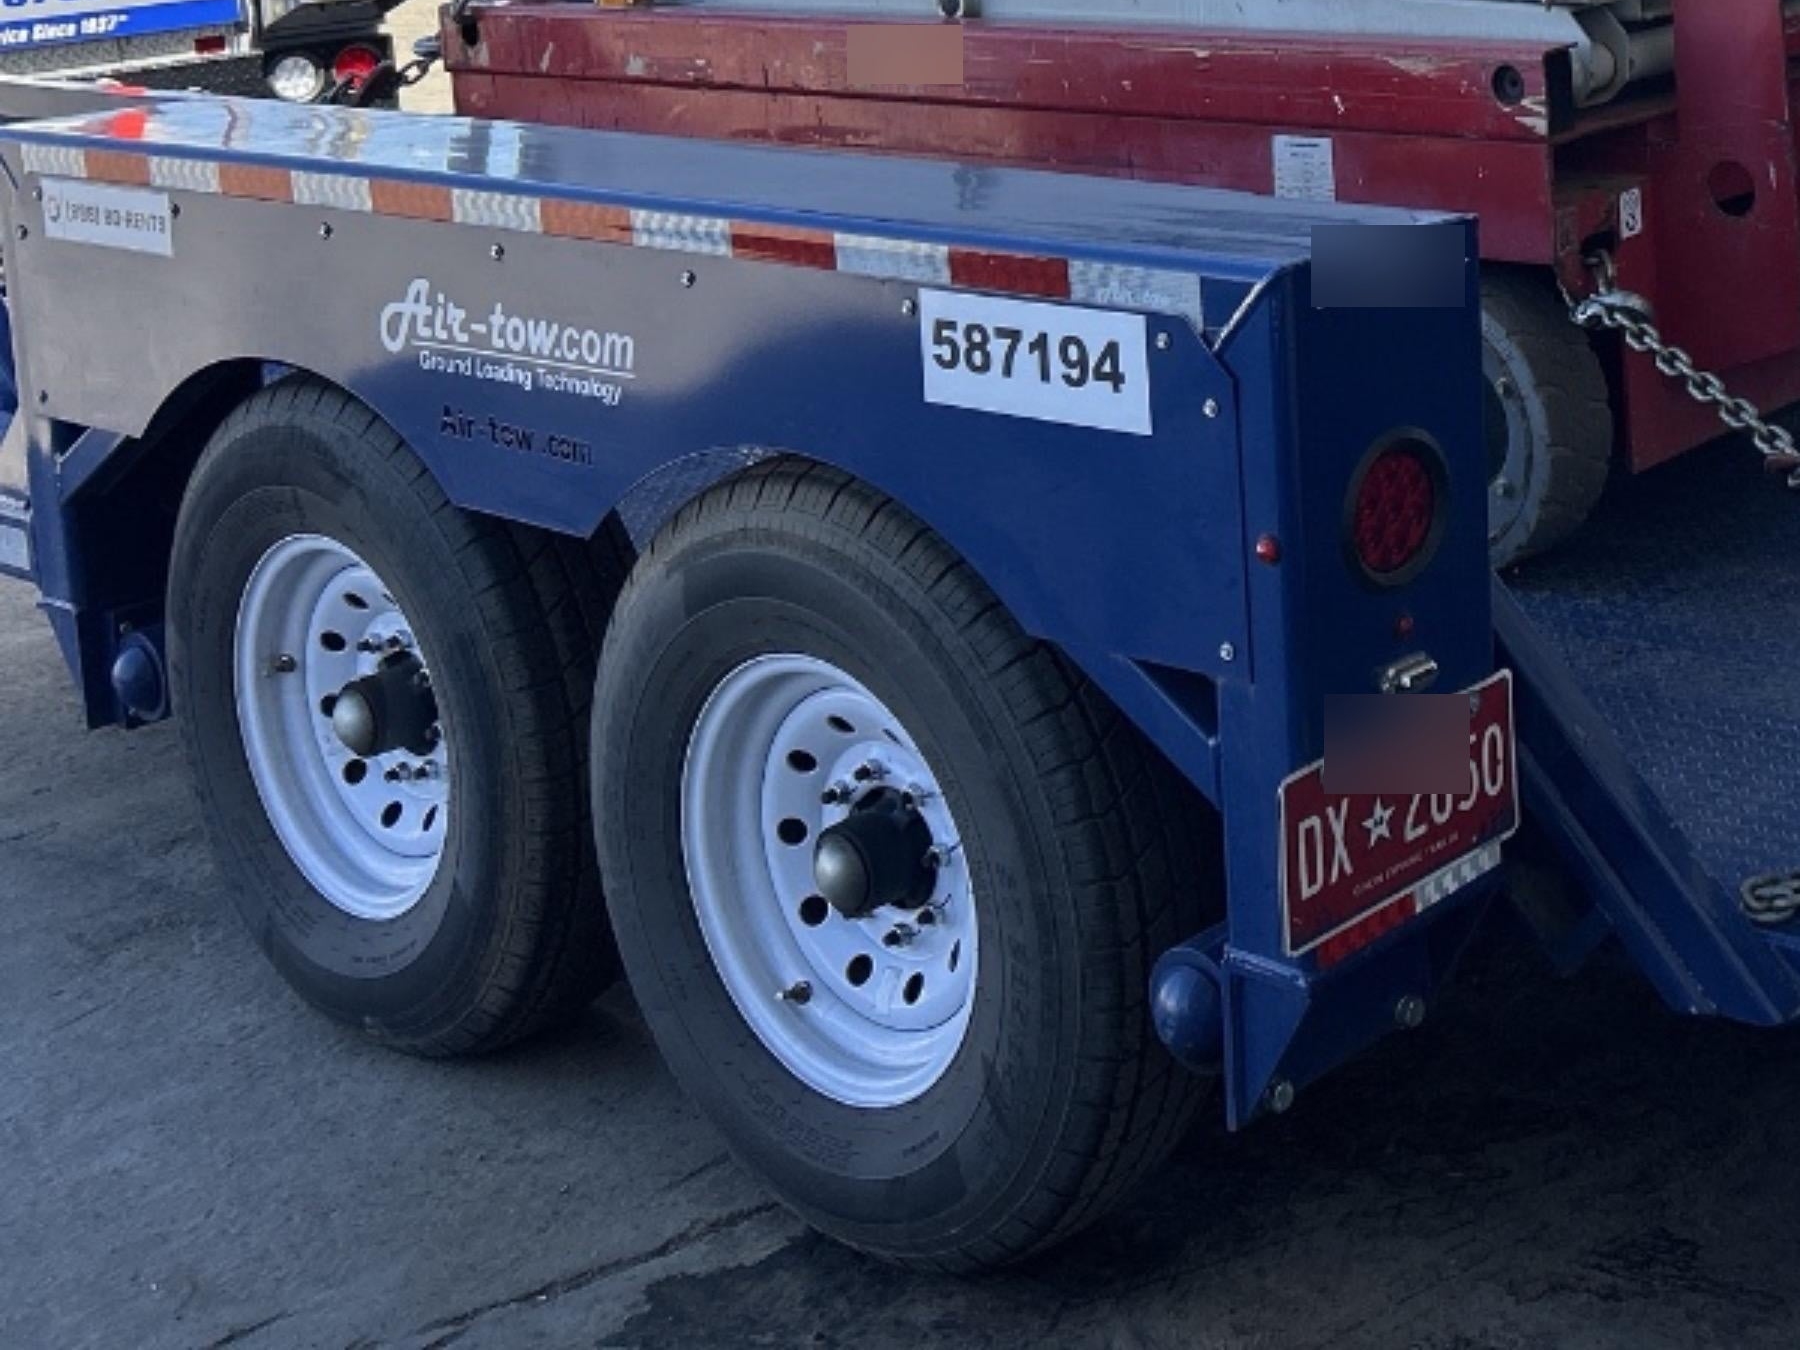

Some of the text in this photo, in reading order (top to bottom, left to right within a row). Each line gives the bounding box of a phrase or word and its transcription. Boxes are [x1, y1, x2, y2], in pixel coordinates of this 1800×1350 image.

[380, 278, 635, 370] Air-tow.com
[932, 318, 1126, 394] 587194
[419, 350, 623, 407] Ground Loading Technology
[1298, 796, 1354, 901] DX
